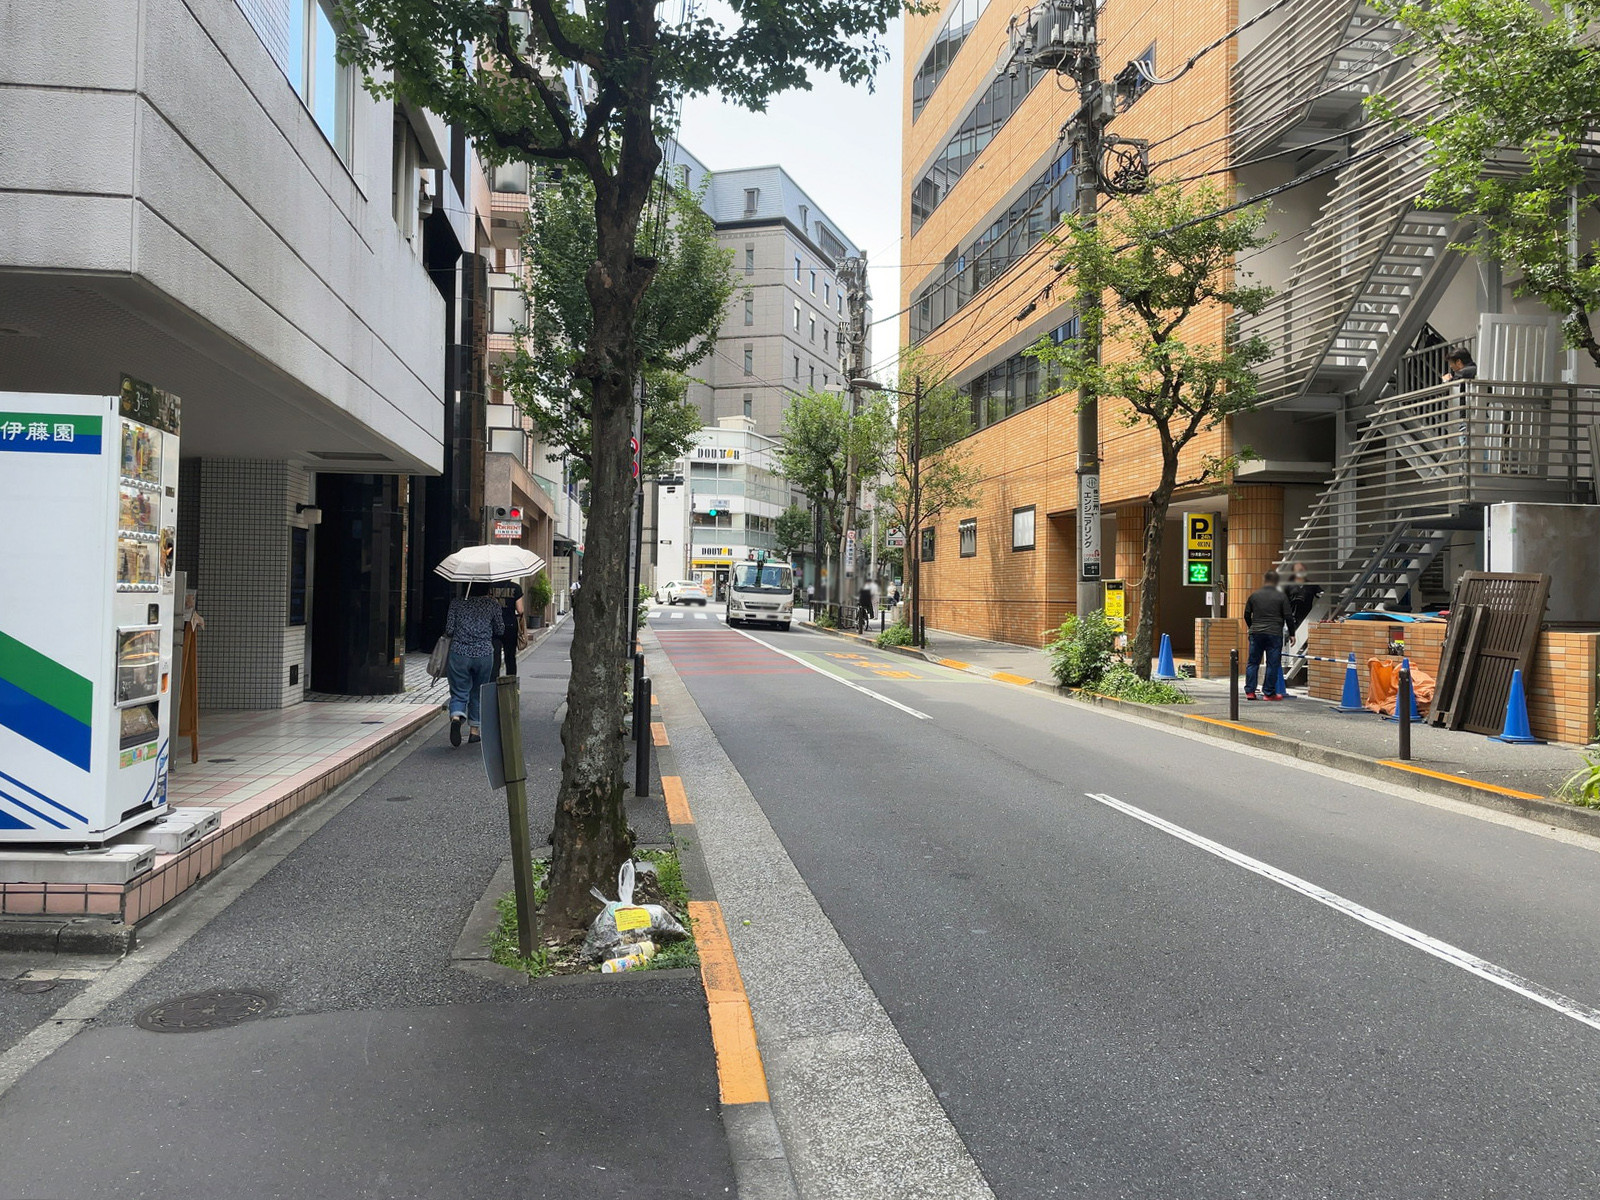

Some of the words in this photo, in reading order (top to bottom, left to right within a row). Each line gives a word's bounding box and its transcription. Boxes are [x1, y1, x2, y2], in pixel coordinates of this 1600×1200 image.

[0, 421, 75, 443] 伊藤園
[697, 447, 740, 460] DOUTOR
[1083, 492, 1093, 549] エンジニアリング
[1191, 518, 1209, 540] P
[701, 547, 733, 556] DOUTOR
